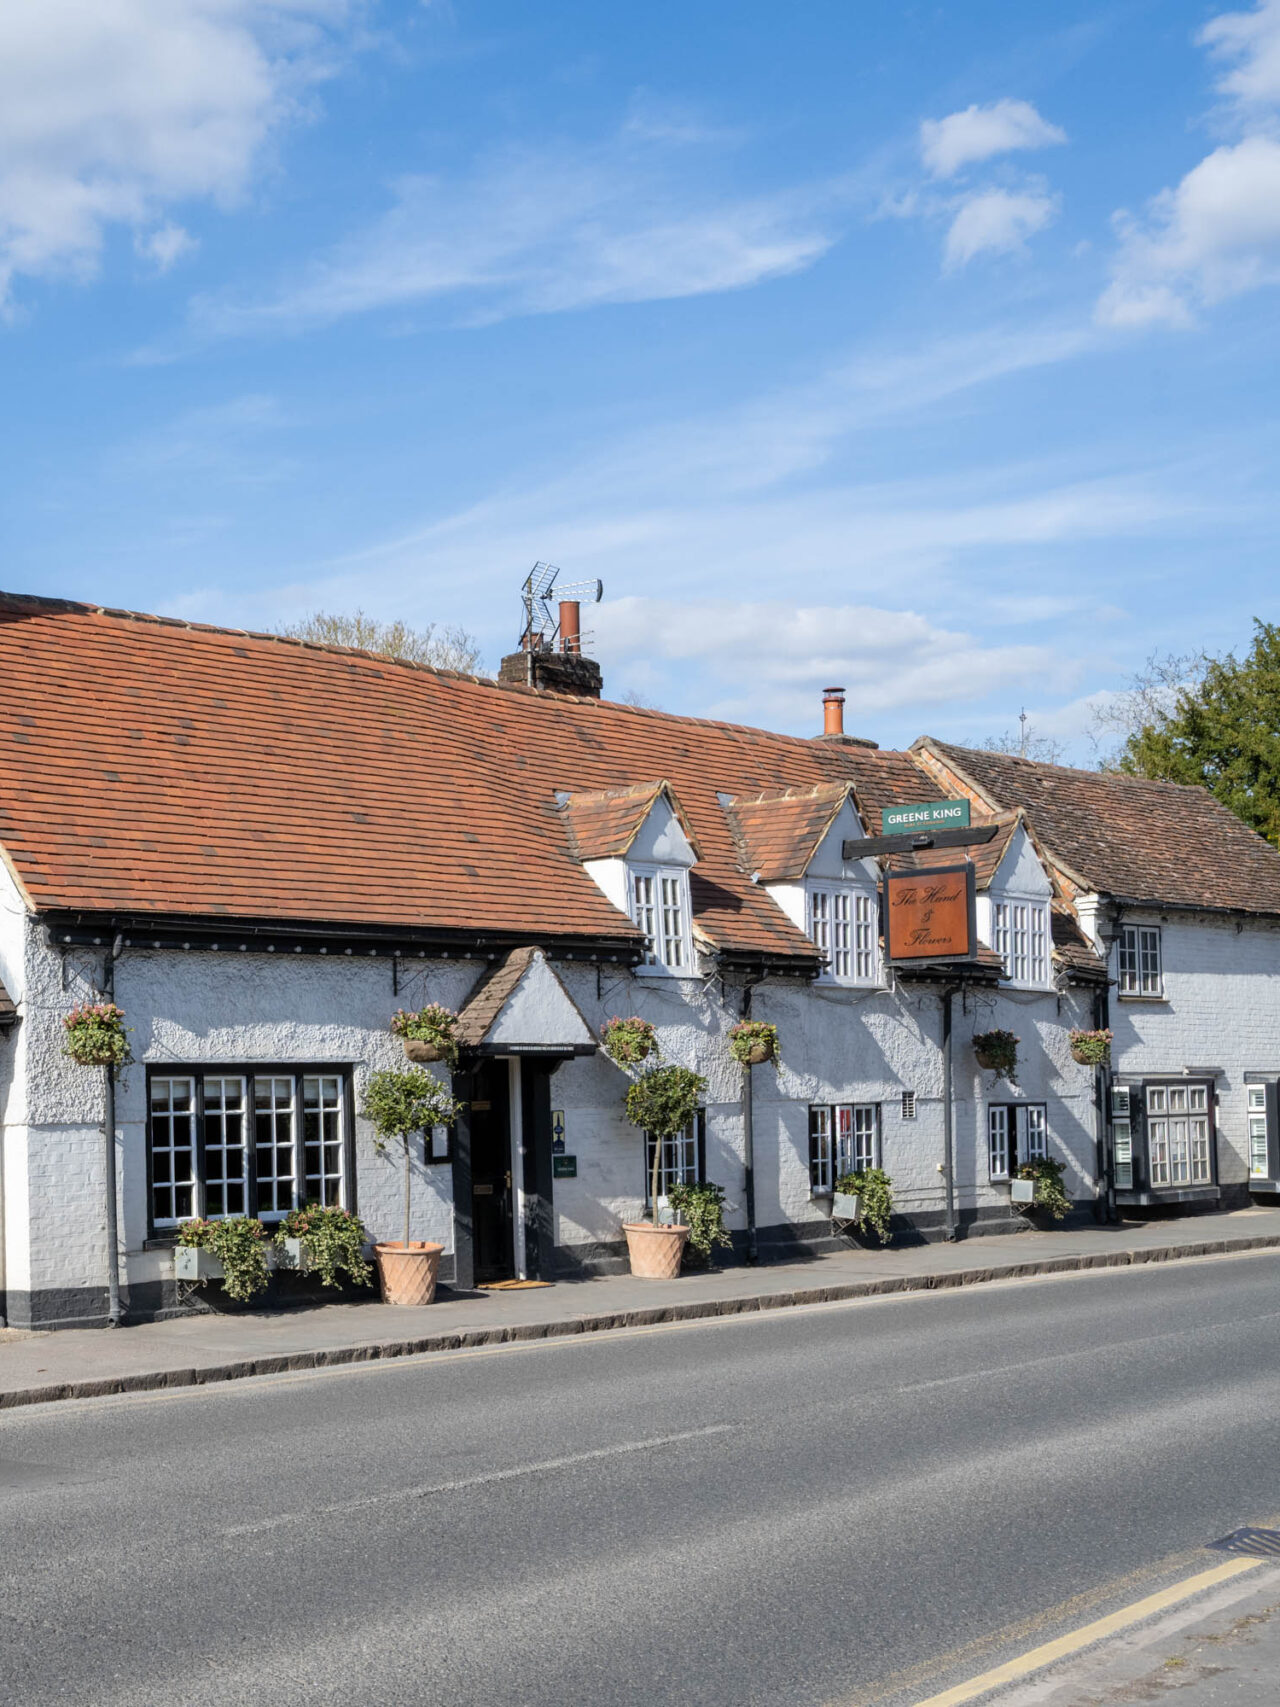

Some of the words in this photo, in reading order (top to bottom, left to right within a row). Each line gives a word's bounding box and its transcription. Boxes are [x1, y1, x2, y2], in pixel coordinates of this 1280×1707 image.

[888, 811, 930, 824] GREENE
[933, 807, 962, 819] KING
[892, 888, 918, 906] The
[920, 885, 962, 904] Hand
[921, 909, 934, 923] &
[904, 928, 952, 946] Flowers
